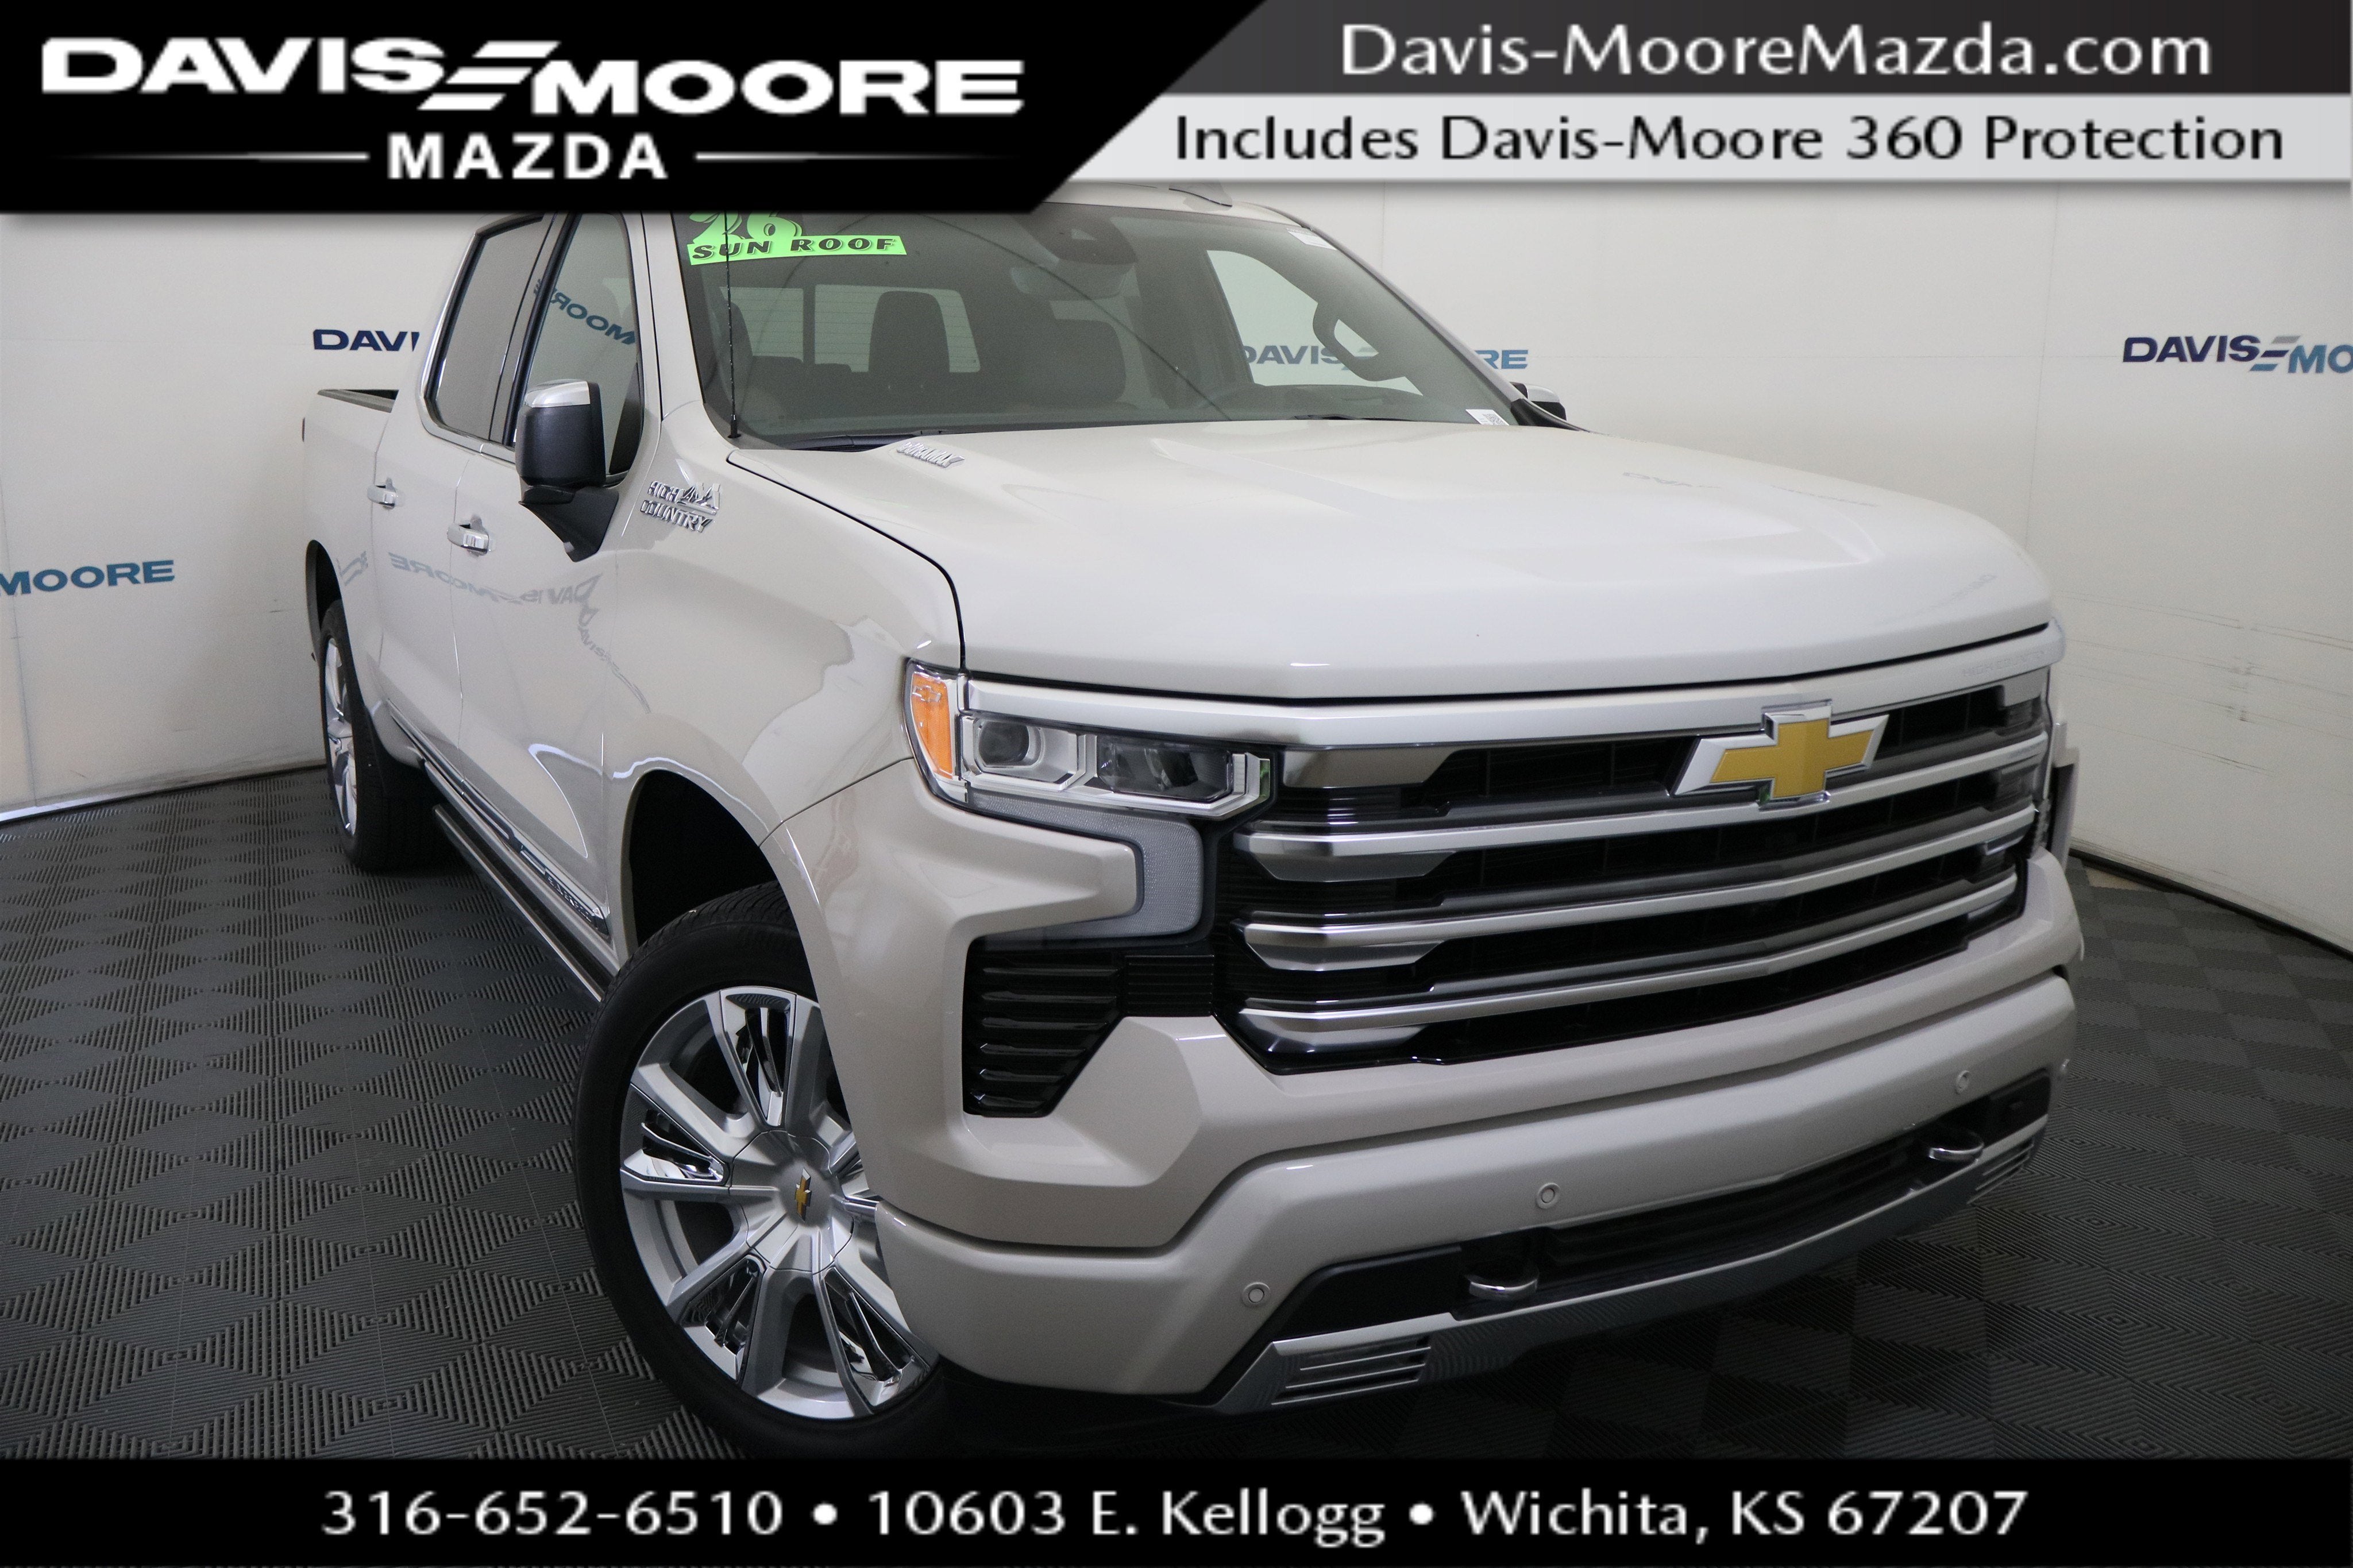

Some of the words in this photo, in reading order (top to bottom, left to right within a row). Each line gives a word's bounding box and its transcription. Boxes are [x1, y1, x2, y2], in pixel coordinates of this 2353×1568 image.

[692, 239, 772, 260] SUN
[790, 238, 896, 252] ROOF
[2123, 335, 2261, 362] DAVIS
[640, 500, 713, 533] COUNTRY
[0, 560, 175, 596] MOORE
